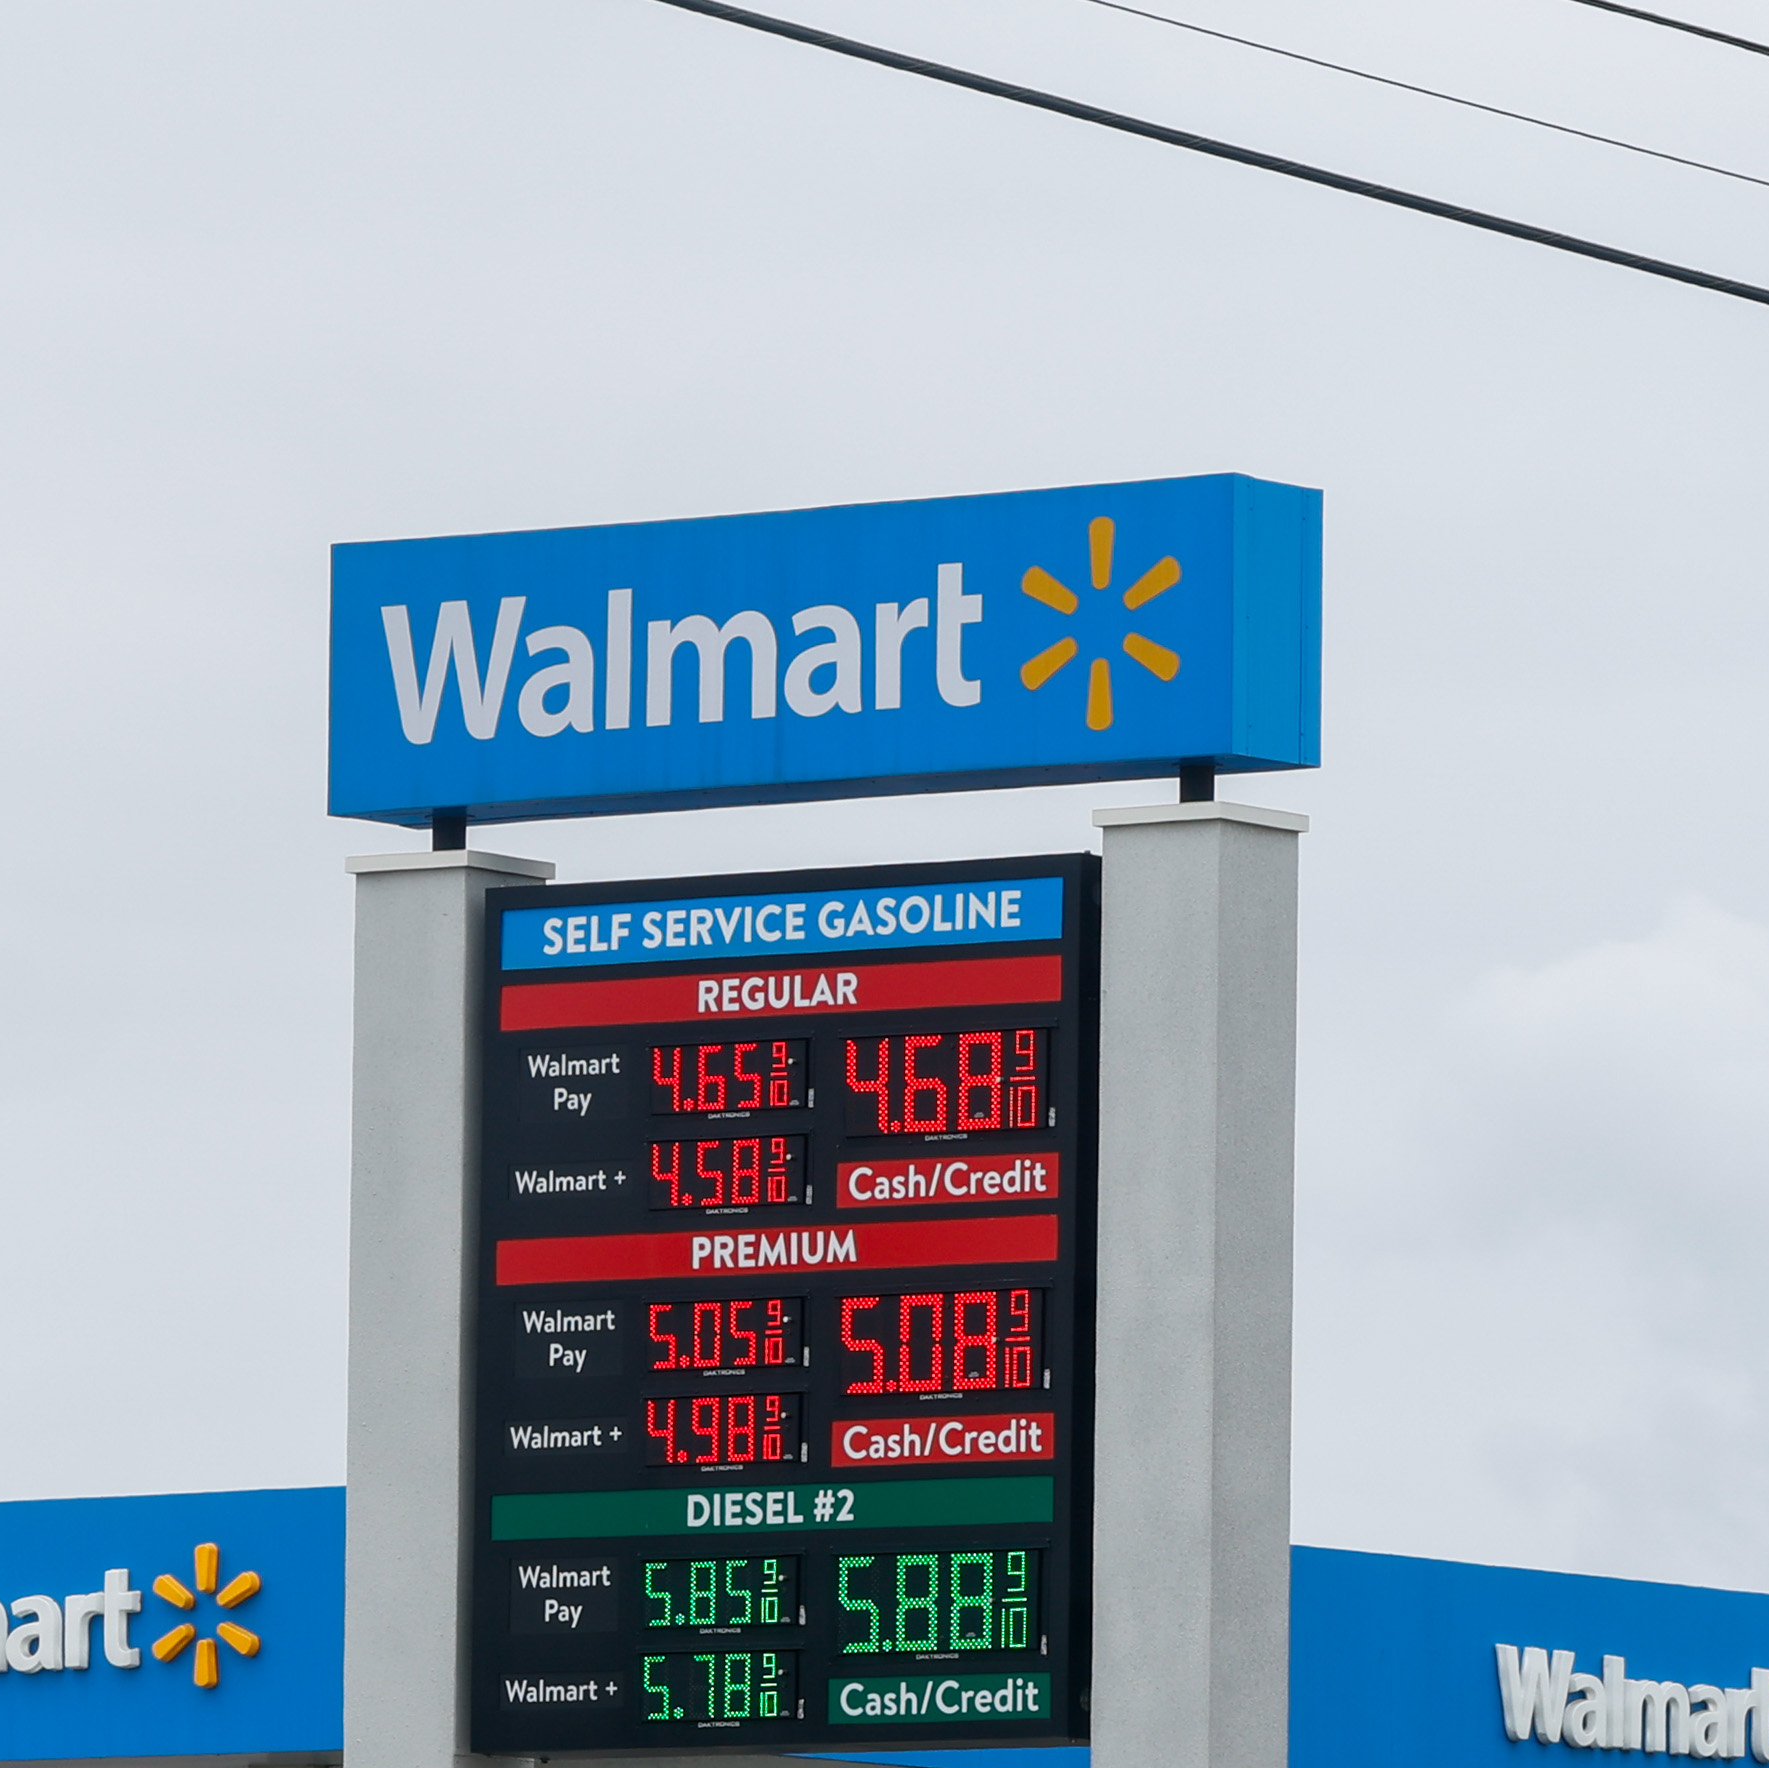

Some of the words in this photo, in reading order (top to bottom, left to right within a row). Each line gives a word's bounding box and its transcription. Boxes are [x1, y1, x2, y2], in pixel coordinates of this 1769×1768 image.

[380, 563, 984, 745] Walmart
[542, 913, 631, 956] SELF
[641, 902, 806, 950] SERVICE
[817, 890, 1022, 939] GASOLINE
[697, 972, 859, 1014] REGULAR
[527, 1053, 620, 1079] Walmart
[553, 1087, 592, 1116] Pay
[515, 1169, 607, 1194] Walmart
[849, 1159, 1047, 1201] Cash/Credit
[692, 1229, 857, 1270] PREMIUM
[522, 1309, 616, 1334] Walmart
[549, 1343, 587, 1373] Pay
[510, 1425, 602, 1449] Walmart
[843, 1418, 1042, 1460] Cash/Credit
[686, 1492, 804, 1527] DIESEL
[813, 1489, 855, 1522] #2
[518, 1564, 611, 1589] Walmart
[544, 1599, 583, 1629] Pay
[505, 1679, 598, 1703] Walmart
[840, 1678, 1039, 1717] Cash/Credit
